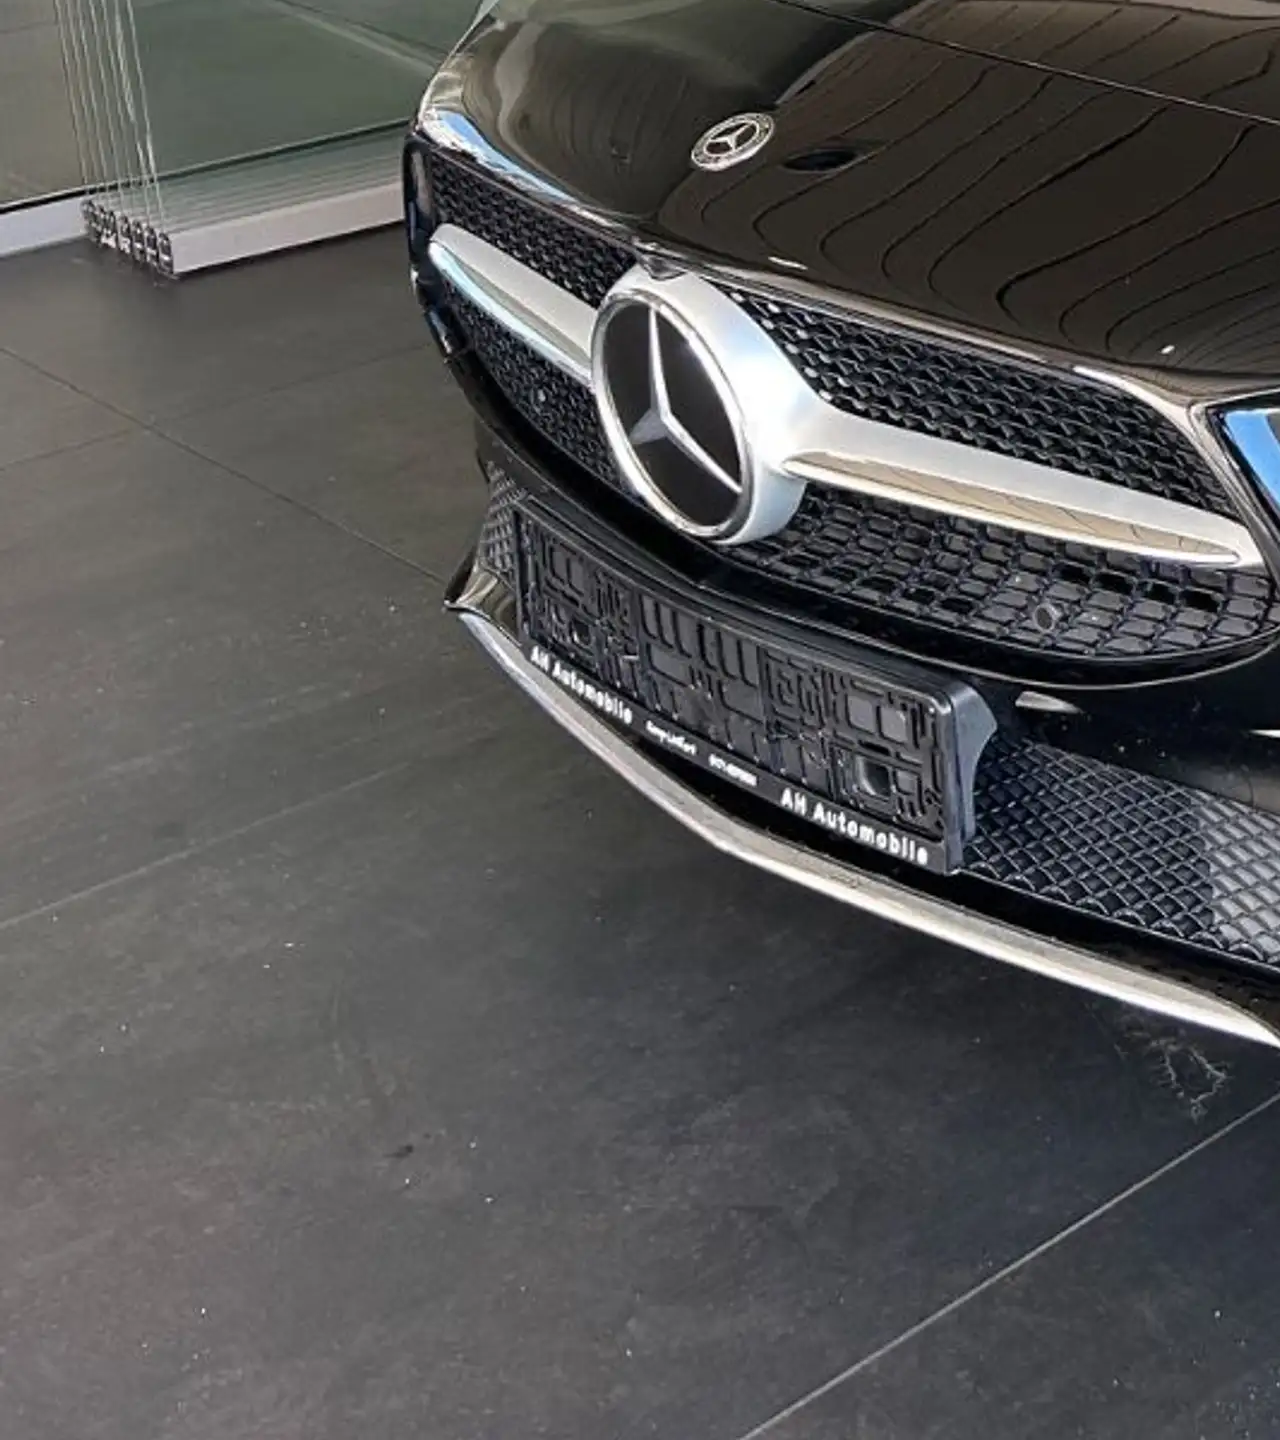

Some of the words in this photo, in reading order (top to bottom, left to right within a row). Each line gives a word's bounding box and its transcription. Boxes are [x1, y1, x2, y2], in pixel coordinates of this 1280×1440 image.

[552, 661, 633, 725] Automobile
[780, 787, 808, 816] AH
[812, 802, 929, 865] Automobile
